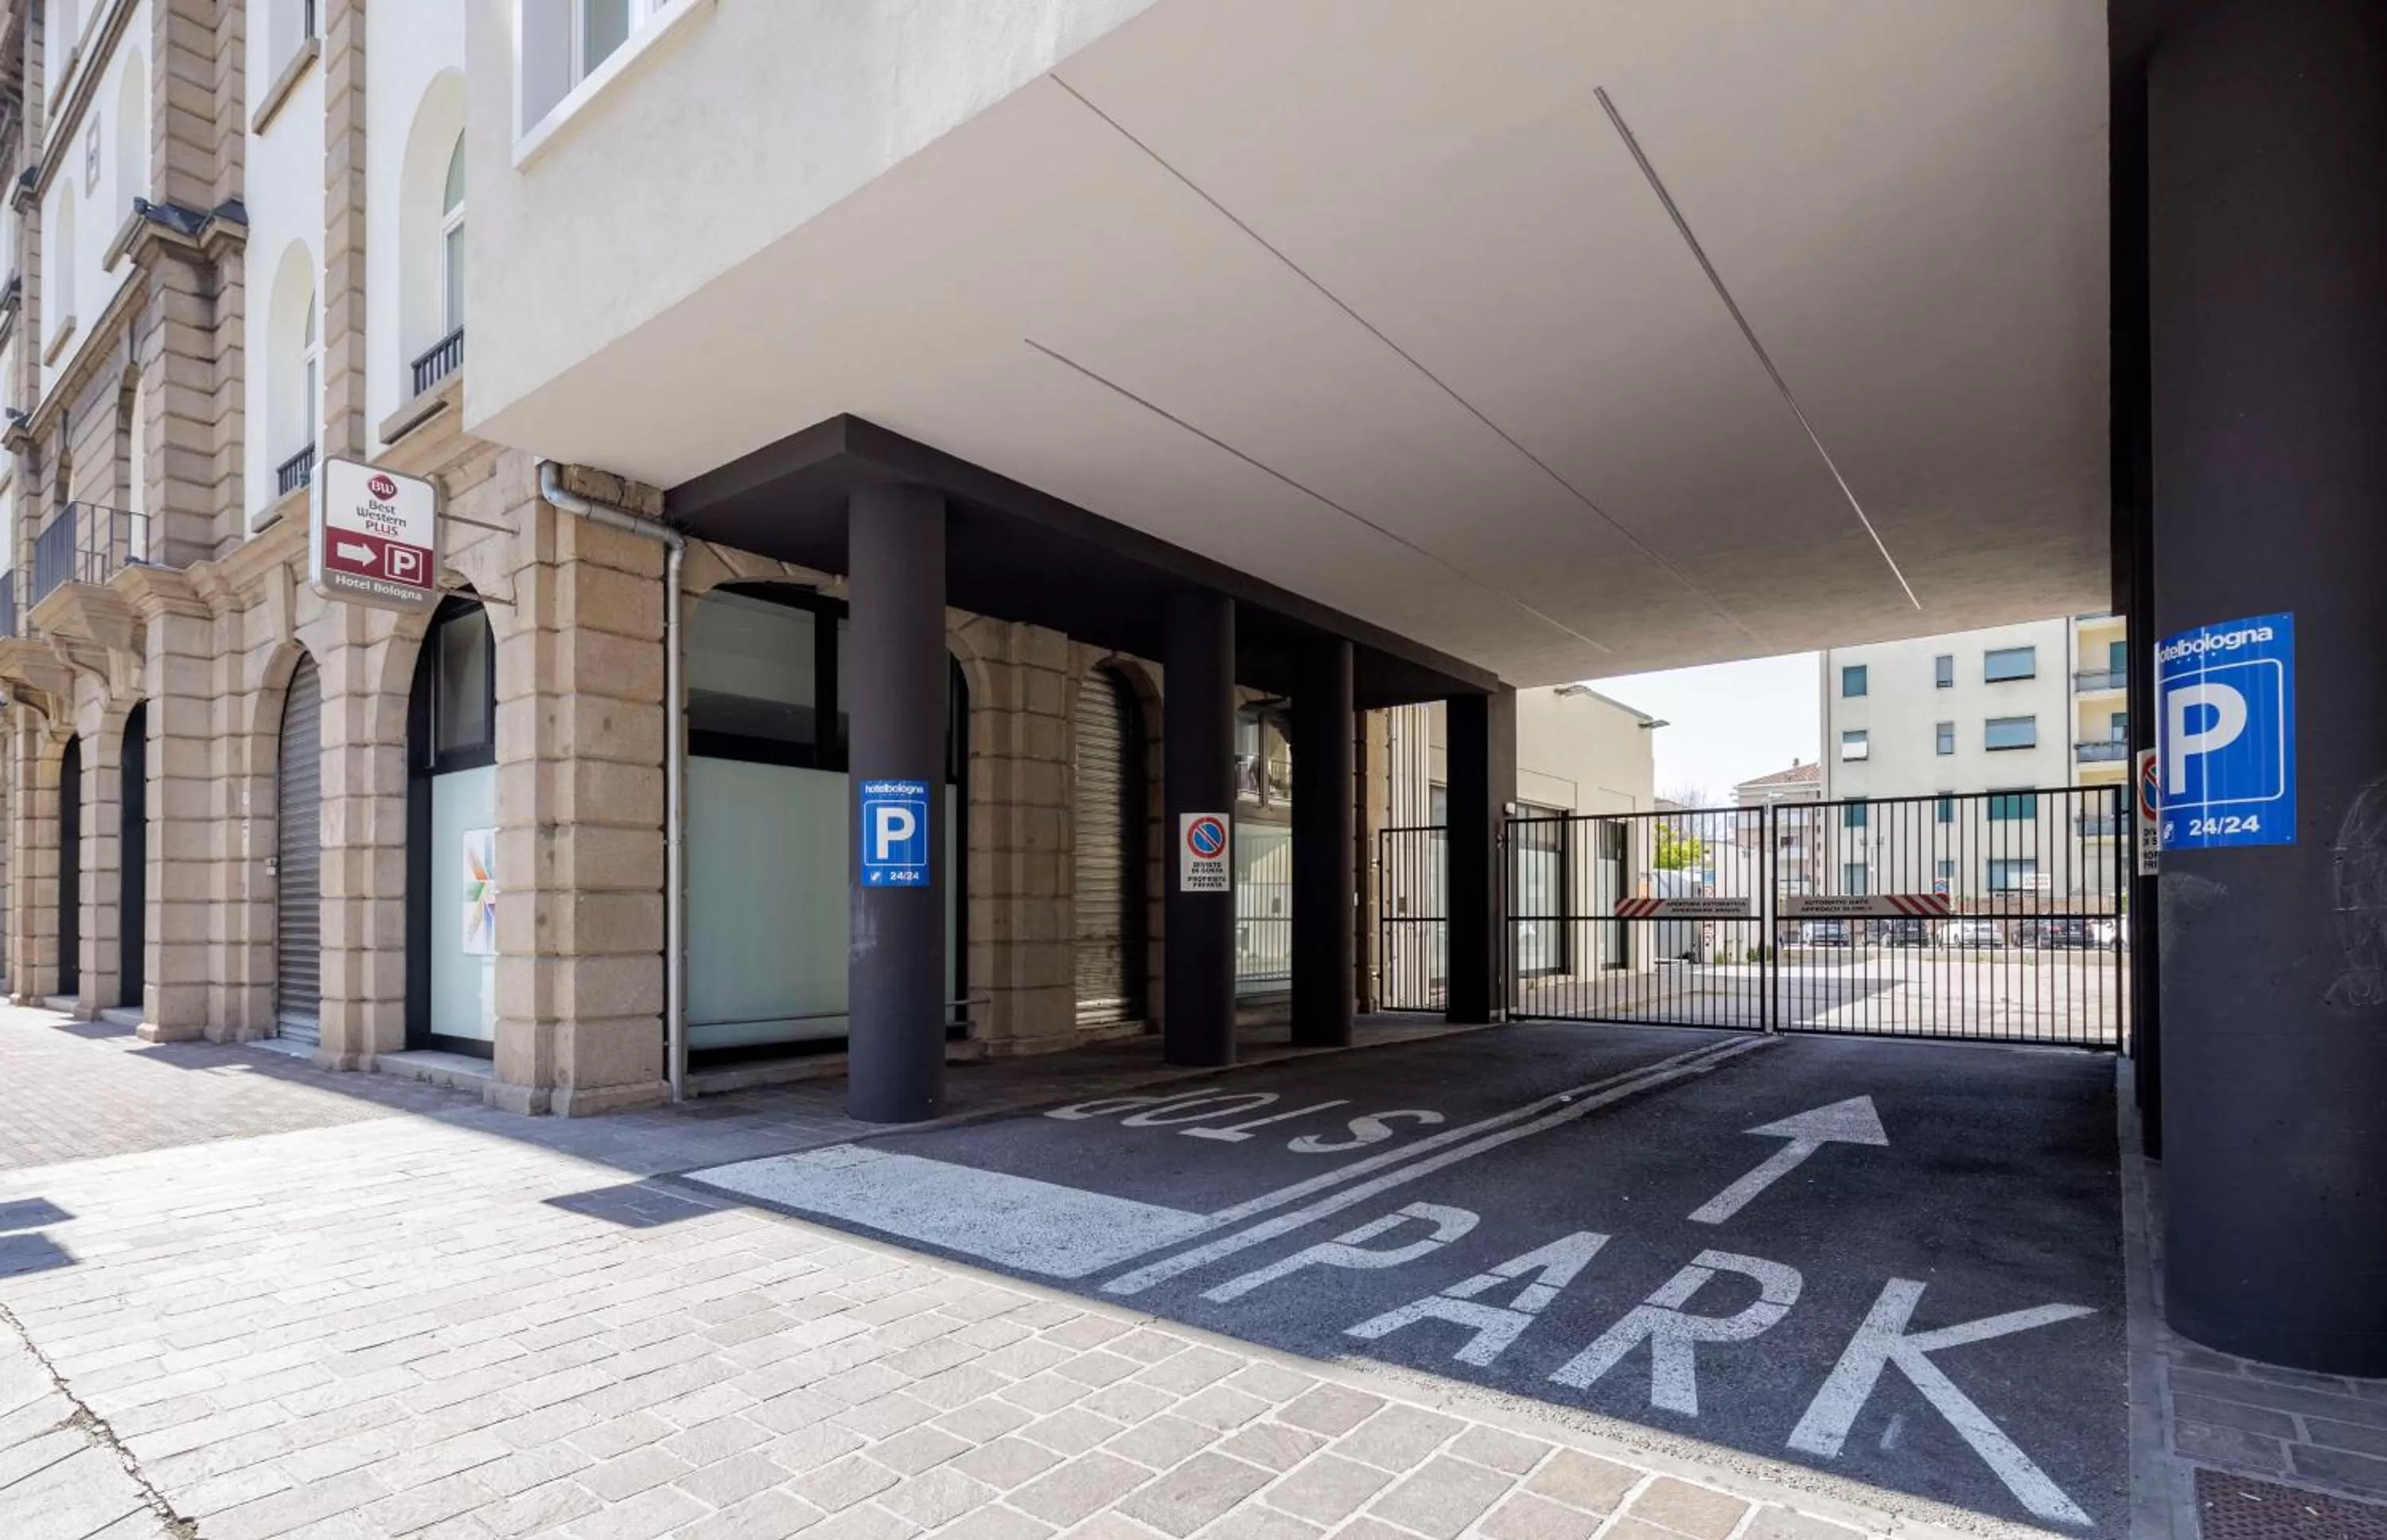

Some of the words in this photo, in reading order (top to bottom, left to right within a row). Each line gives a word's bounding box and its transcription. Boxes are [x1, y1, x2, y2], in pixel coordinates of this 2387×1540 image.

[371, 480, 395, 495] BW
[356, 505, 407, 529] Western
[368, 499, 395, 515] Best
[365, 519, 399, 536] PLUS
[394, 550, 416, 575] P
[335, 574, 371, 591] Hotel
[372, 581, 423, 602] Bologna
[2167, 682, 2248, 796] P
[865, 783, 924, 795] hotelbologna
[876, 807, 916, 860] P
[2189, 815, 2260, 836] 24/24
[890, 871, 920, 881] 24/24
[1199, 1201, 2098, 1528] PARK
